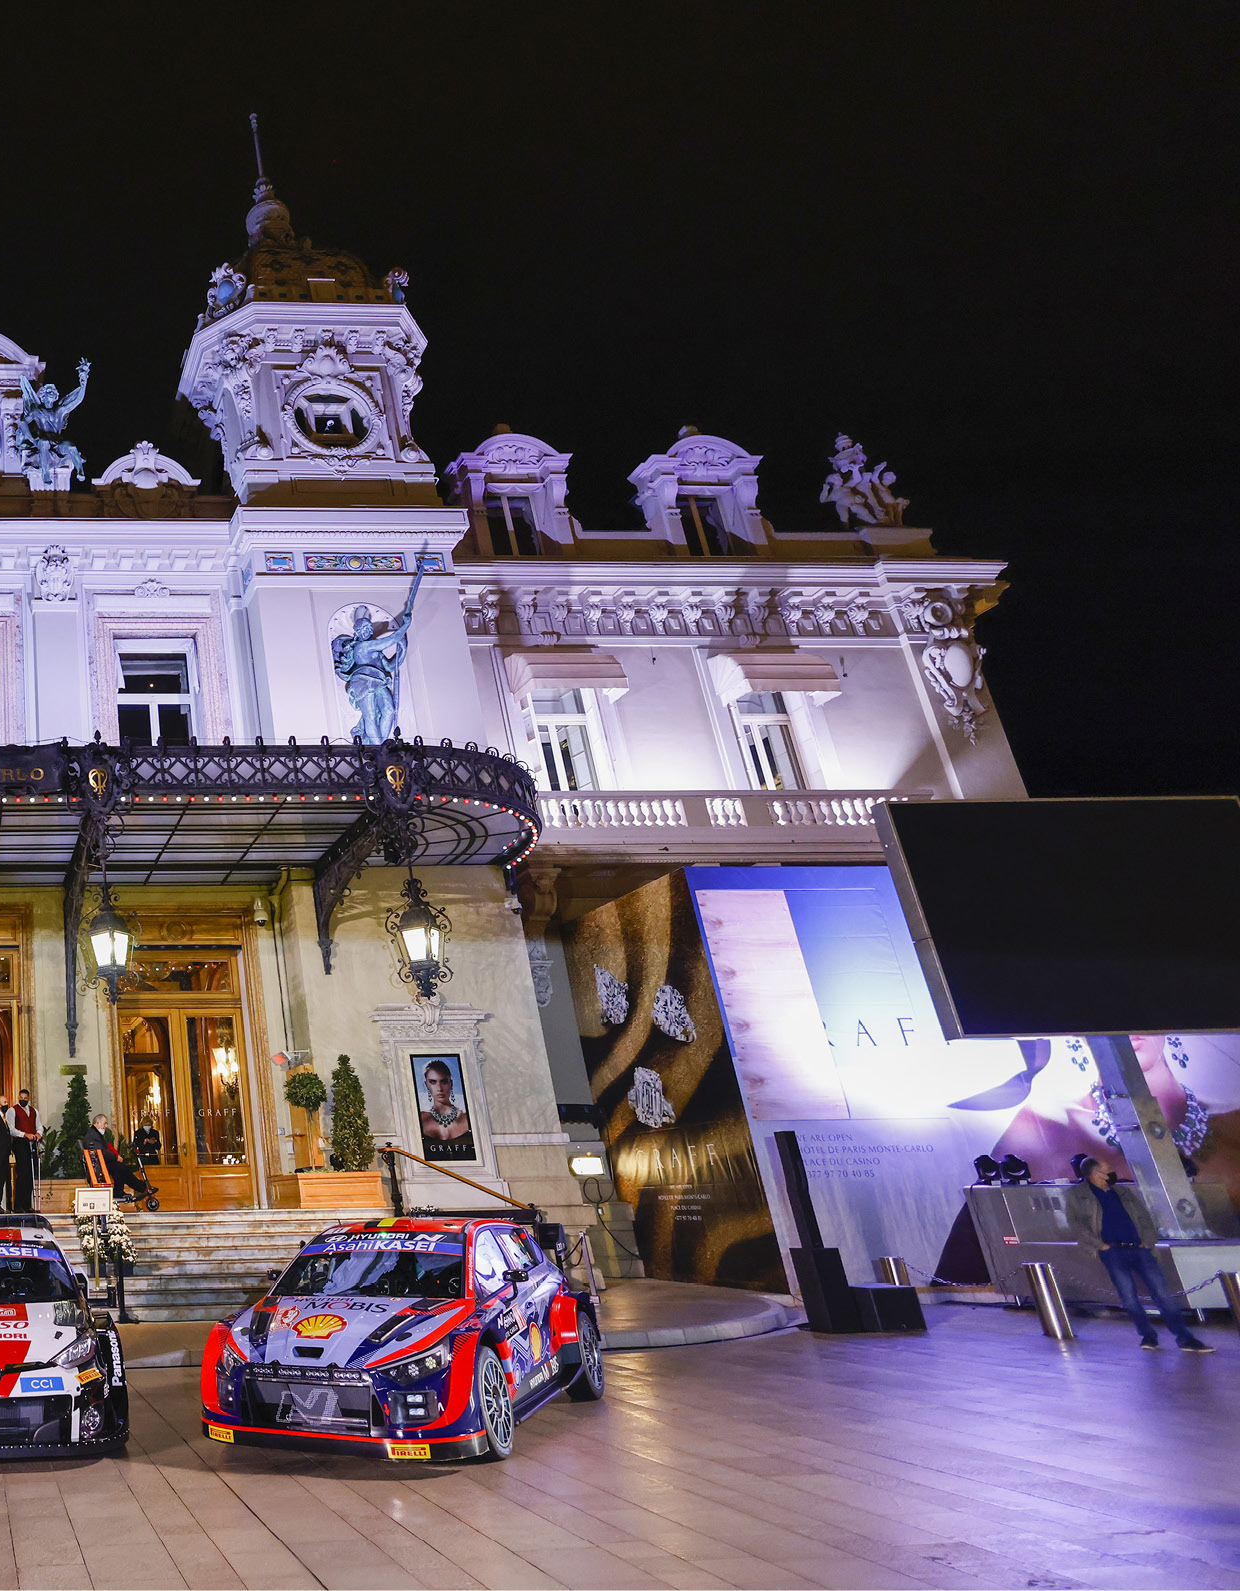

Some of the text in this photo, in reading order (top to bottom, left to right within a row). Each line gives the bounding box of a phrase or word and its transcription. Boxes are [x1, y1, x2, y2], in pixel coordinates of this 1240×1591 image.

[198, 1108, 237, 1116] GRAFF
[828, 1134, 854, 1142] OPEN
[868, 1144, 934, 1153] MONTE-CARLO
[804, 1158, 826, 1166] LACE
[846, 1157, 880, 1165] CASINO
[824, 1170, 834, 1178] 97
[304, 1302, 390, 1314] MOBIS
[106, 1330, 123, 1386] Panasonic
[210, 1428, 232, 1440] PIRELLI
[391, 1447, 427, 1457] PIRELLI
